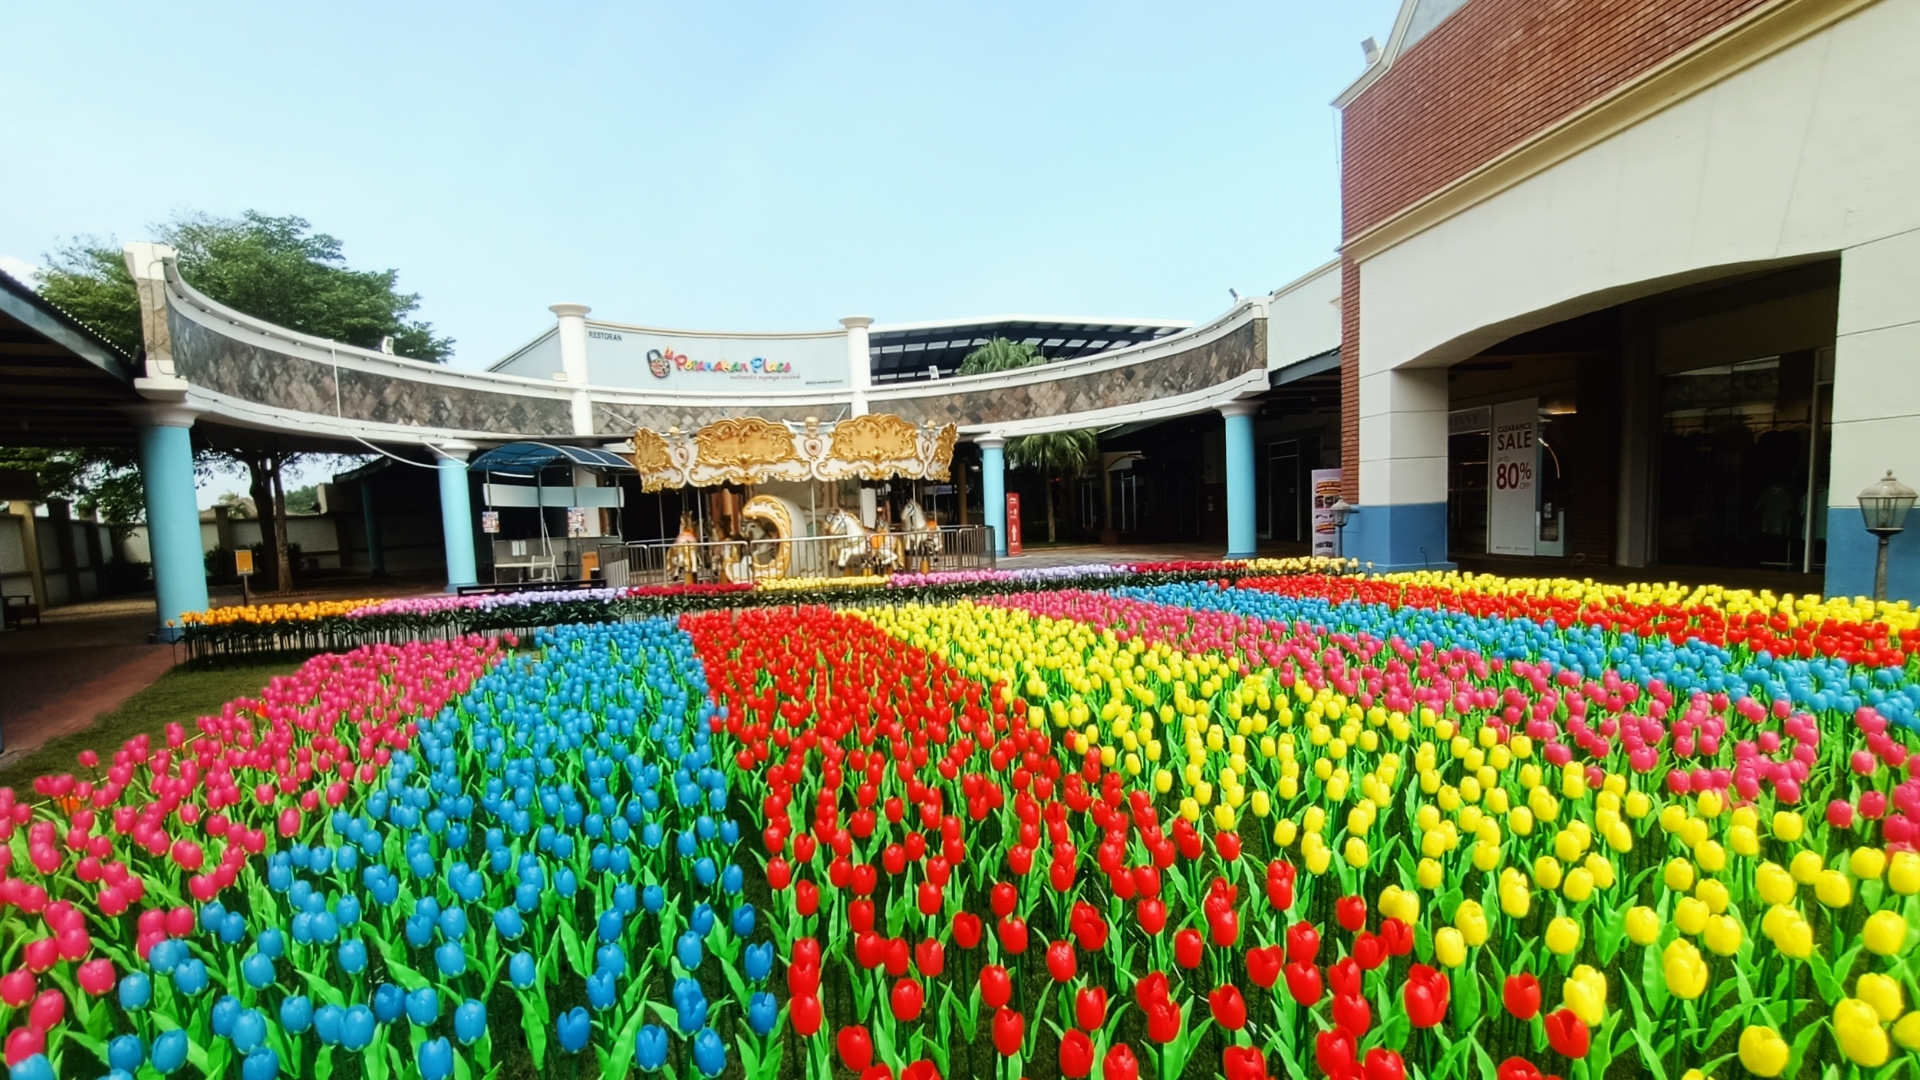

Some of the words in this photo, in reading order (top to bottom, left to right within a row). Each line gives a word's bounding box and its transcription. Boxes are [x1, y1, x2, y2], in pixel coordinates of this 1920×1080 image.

[589, 331, 622, 341] RESTORAN
[674, 354, 748, 373] Peranakan
[750, 357, 791, 373] Place
[1497, 422, 1532, 433] CLEARANCE
[1497, 431, 1532, 451] SALE
[1496, 462, 1532, 490] 80%
[1519, 482, 1531, 490] OFF
